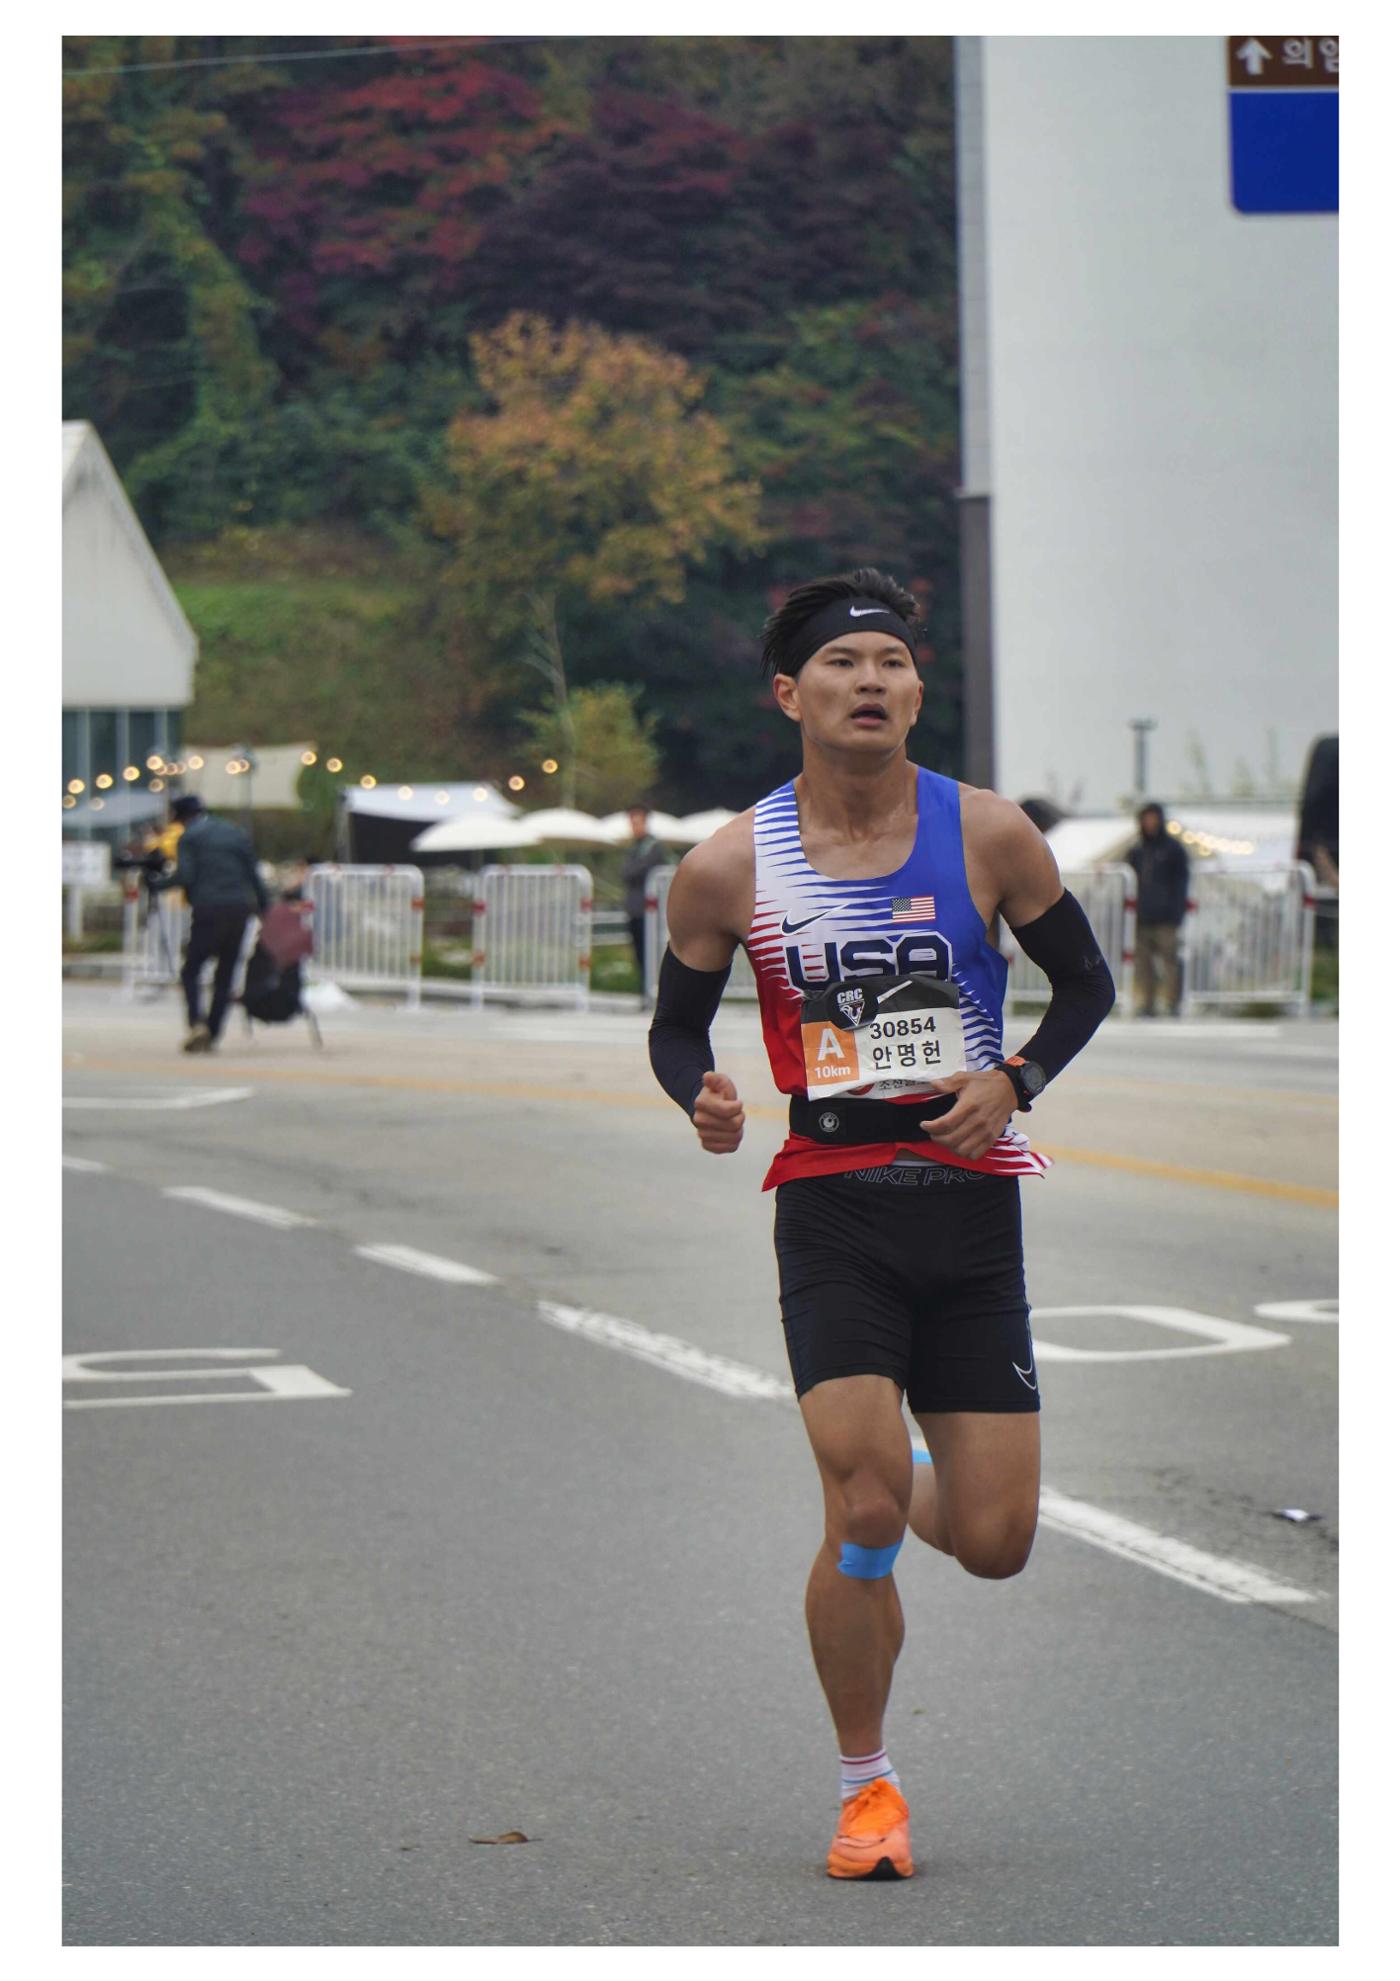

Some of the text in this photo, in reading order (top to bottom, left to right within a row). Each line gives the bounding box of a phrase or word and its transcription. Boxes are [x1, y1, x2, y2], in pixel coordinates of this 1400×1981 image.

[785, 934, 951, 990] USA
[837, 988, 863, 1004] CRC
[870, 1016, 936, 1040] 30854
[817, 1028, 845, 1061] A
[873, 1040, 941, 1071] 안명헌
[815, 1065, 851, 1080] 10km
[844, 1167, 921, 1186] NIKE
